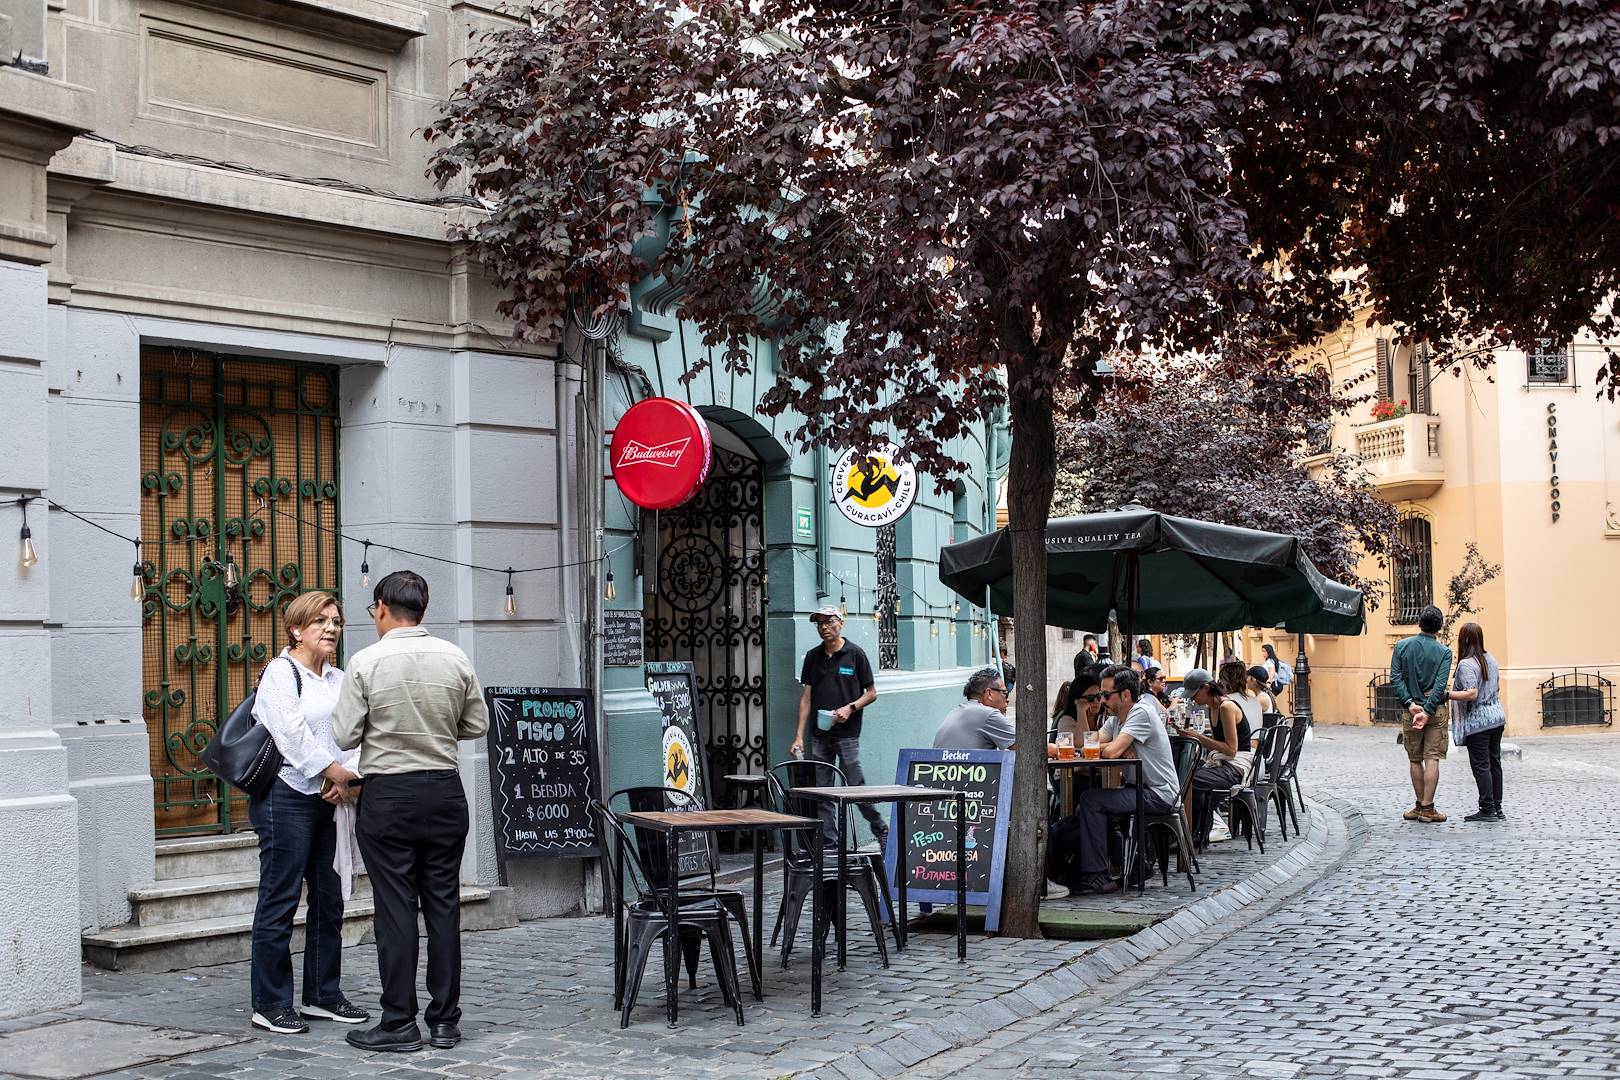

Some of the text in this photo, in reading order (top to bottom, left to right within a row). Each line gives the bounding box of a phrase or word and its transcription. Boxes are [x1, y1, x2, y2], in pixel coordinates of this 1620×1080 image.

[623, 445, 682, 460] Budweiser
[1547, 402, 1561, 524] CONAVICOOP
[1077, 533, 1120, 544] QUALITY
[1125, 531, 1142, 540] TEA
[1339, 602, 1352, 610] TEA
[522, 700, 576, 719] PROMO
[516, 720, 565, 741] PISCO
[505, 747, 516, 764] 2
[523, 748, 548, 764] ALTO
[555, 751, 565, 760] DE
[942, 750, 970, 761] Becker
[913, 763, 987, 782] PROMO
[514, 783, 577, 799] 1 BEBIDA
[515, 830, 538, 840] HASTA
[926, 849, 978, 863] BOLOGSA
